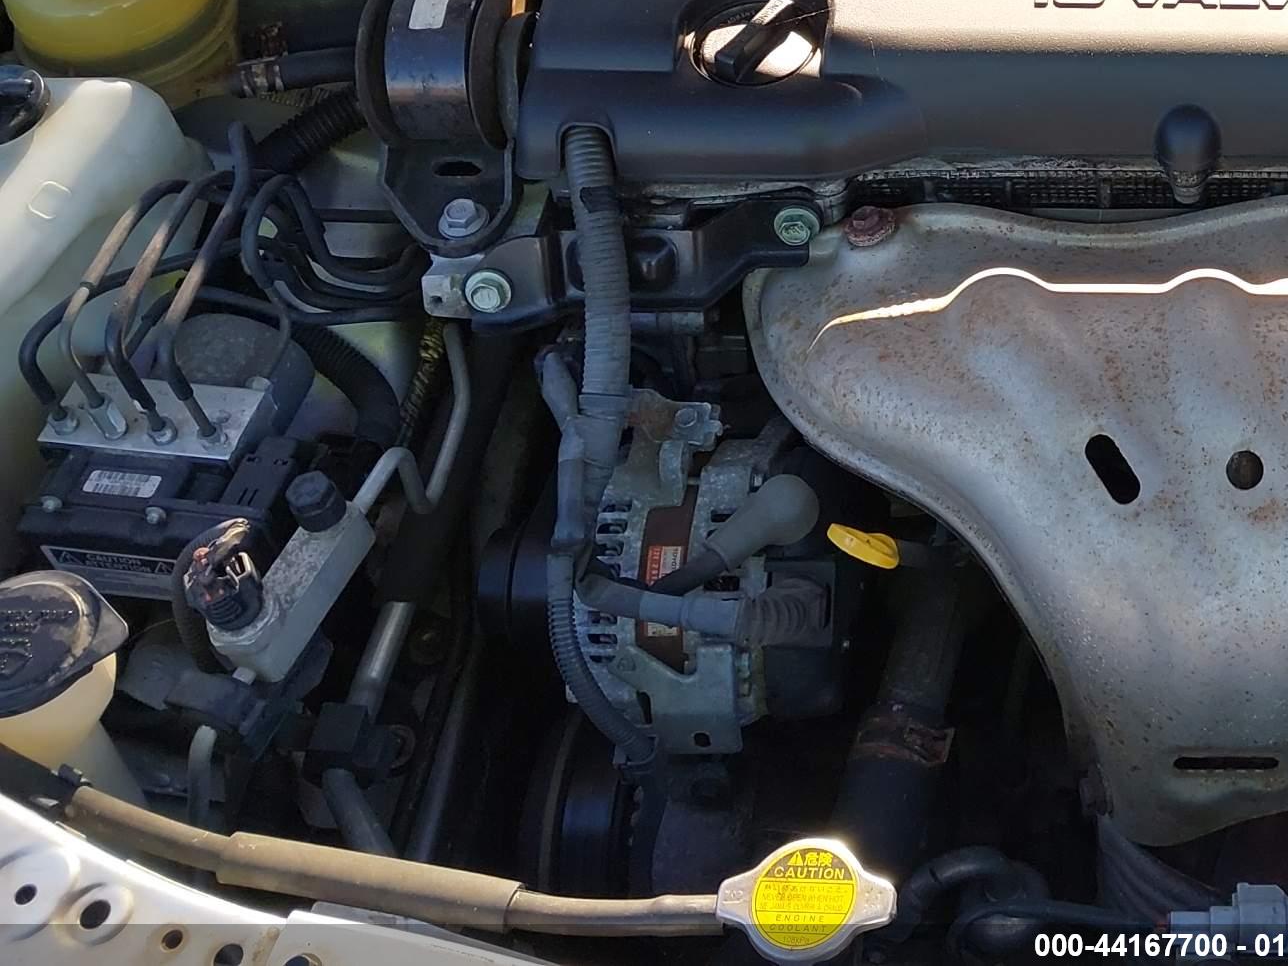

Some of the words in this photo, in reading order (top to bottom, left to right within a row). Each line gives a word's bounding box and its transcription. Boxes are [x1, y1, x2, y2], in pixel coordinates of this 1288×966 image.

[804, 851, 834, 867] 危険
[774, 866, 845, 880] CAUTION
[776, 915, 826, 923] ENGINE
[769, 924, 828, 933] COOLANT
